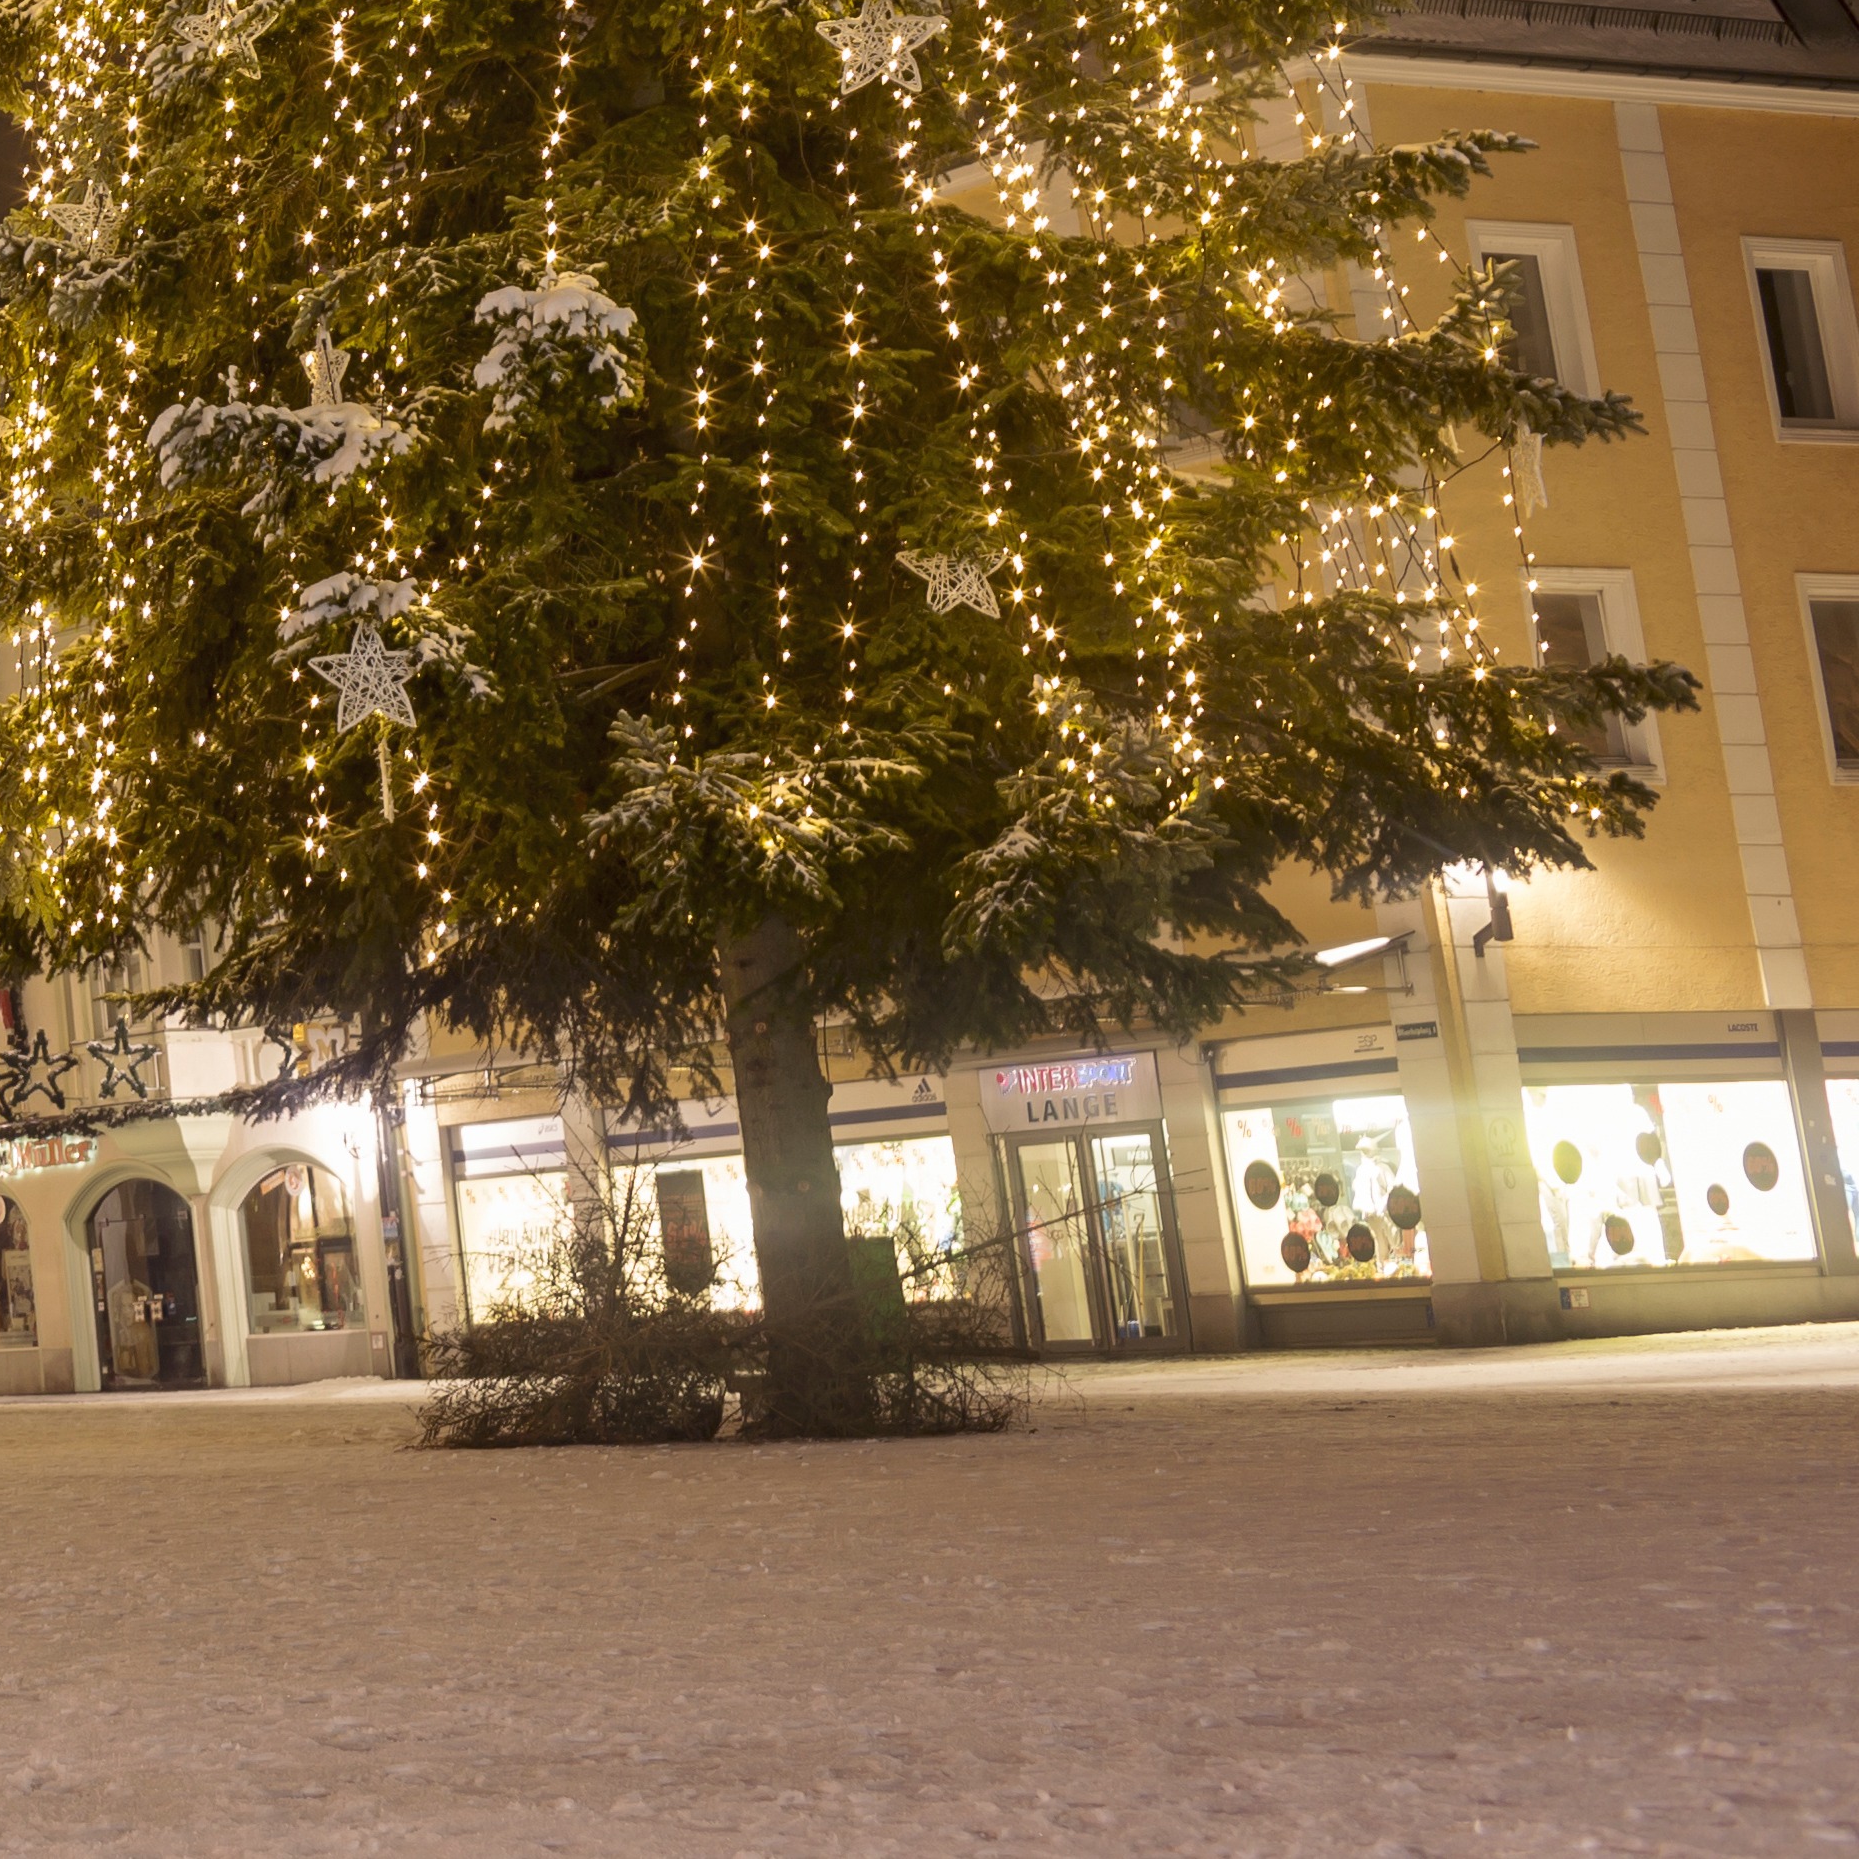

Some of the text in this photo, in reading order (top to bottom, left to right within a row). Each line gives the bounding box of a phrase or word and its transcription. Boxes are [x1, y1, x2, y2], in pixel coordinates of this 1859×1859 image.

[1728, 1023, 1758, 1032] LACOSTE
[1018, 1058, 1137, 1094] INTERSPORT
[1027, 1094, 1119, 1124] LANGE
[13, 1137, 94, 1170] Müller
